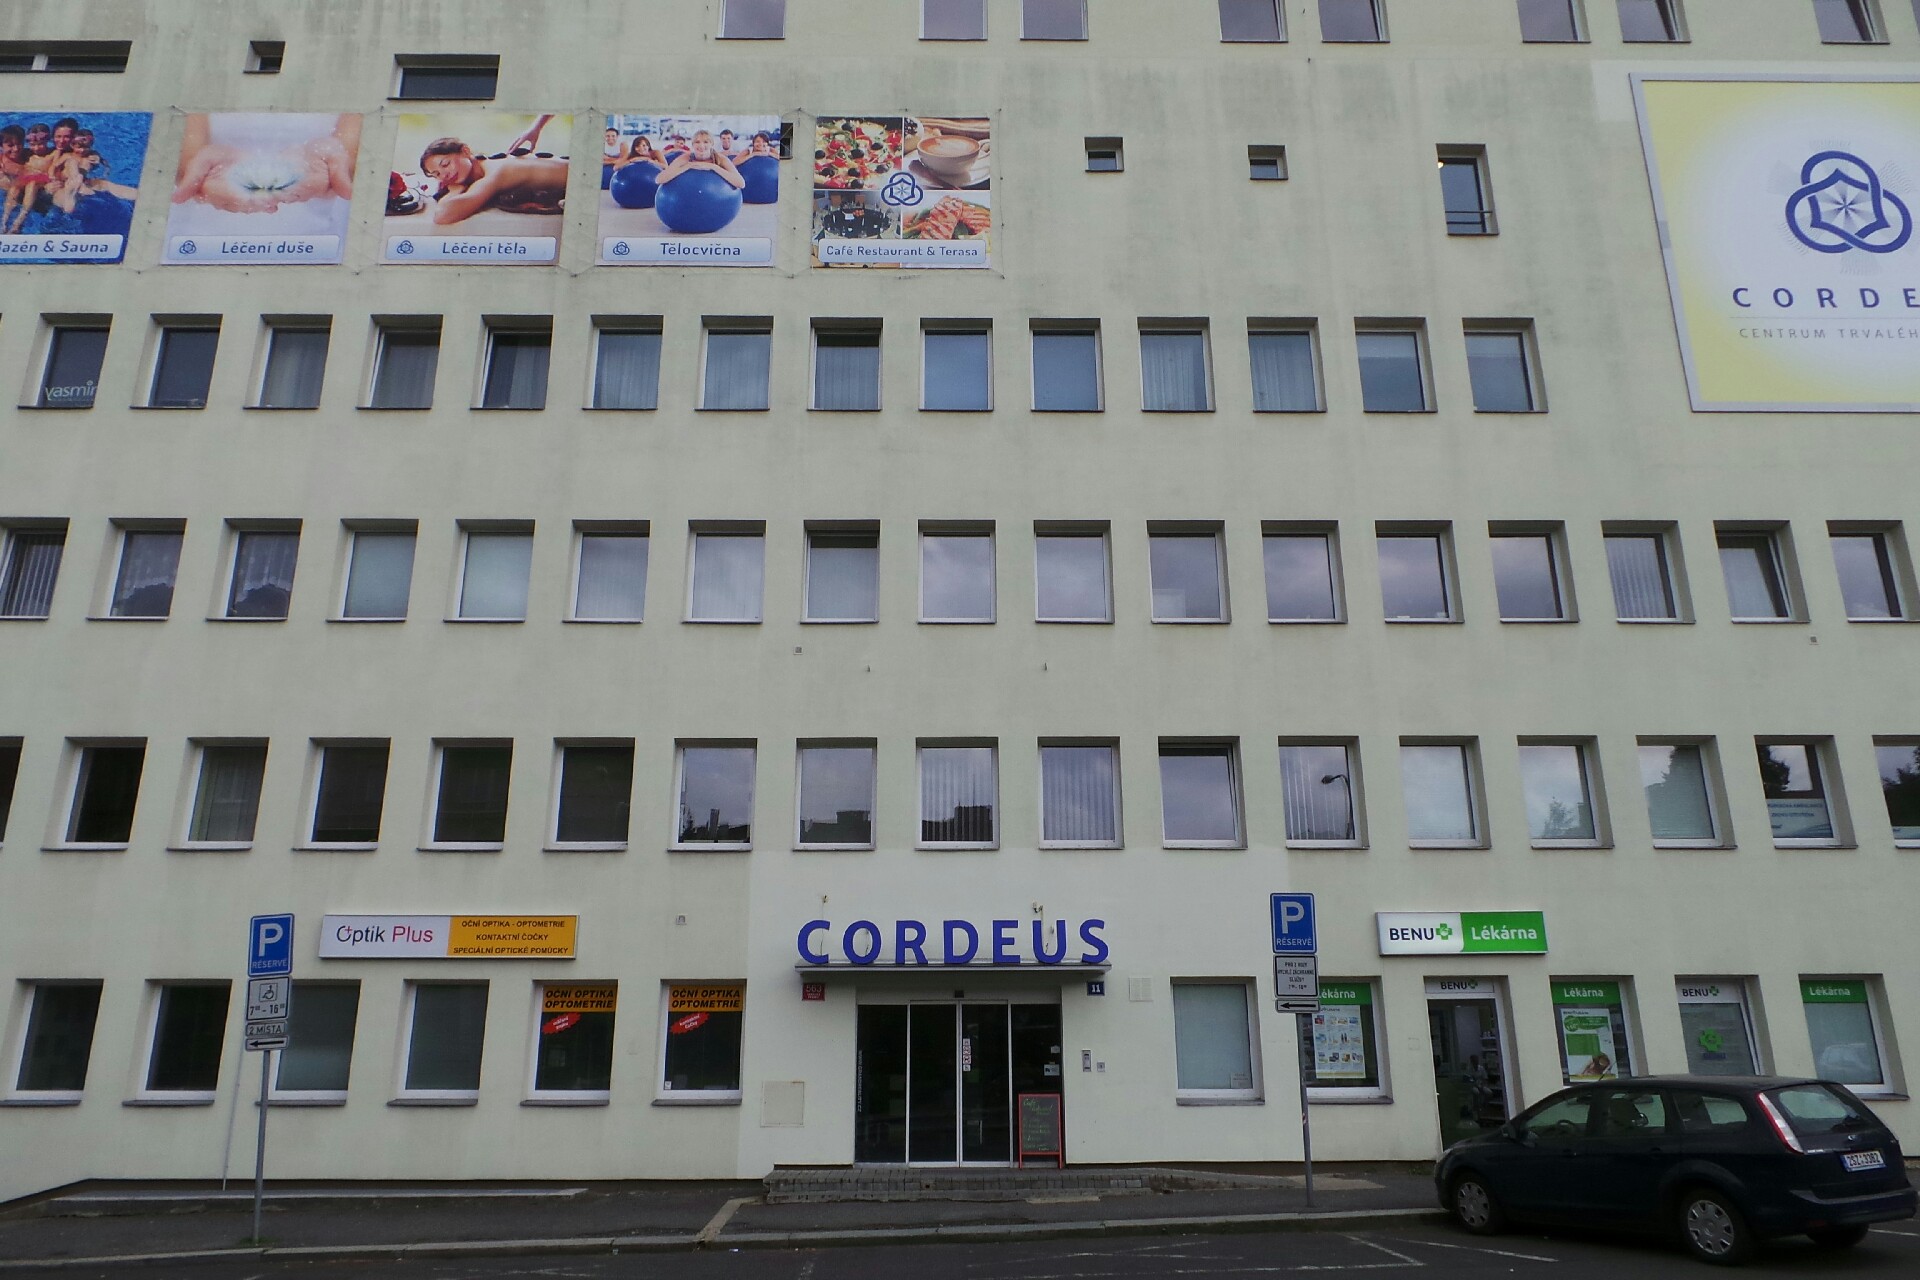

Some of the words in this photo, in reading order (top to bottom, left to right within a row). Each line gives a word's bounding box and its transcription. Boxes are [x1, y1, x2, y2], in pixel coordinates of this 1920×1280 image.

[43, 240, 54, 253] &
[60, 240, 109, 253] Sauna
[222, 241, 273, 254] Léčení
[276, 241, 314, 254] duše
[442, 242, 493, 255] Léčení
[497, 242, 527, 255] těla
[660, 241, 741, 257] Tělocvična
[826, 245, 854, 257] Café
[856, 245, 923, 257] Restaurant
[926, 246, 936, 257] &
[939, 246, 979, 257] Terasa
[1732, 287, 1920, 308] CORDE
[1739, 328, 1826, 339] CENTRUM
[1838, 326, 1918, 339] TRVALÉH
[461, 919, 480, 928] OČNÍ
[482, 920, 510, 928] OPTIKA
[516, 920, 565, 928] OPTOMETRIE
[1280, 901, 1305, 934] P
[336, 925, 386, 947] Optik
[392, 925, 433, 943] Plus
[476, 933, 520, 941] KONTAKTNÍ
[521, 933, 549, 941] ČOČKY
[1389, 928, 1434, 941] BENU
[1471, 924, 1538, 940] Lékárna
[258, 922, 284, 957] P
[797, 919, 1109, 964] CORDEUS
[453, 946, 494, 954] SPECIÁLNÍ
[494, 946, 529, 954] OPTICKÉ
[1091, 984, 1101, 993] 11
[1440, 981, 1468, 990] BENU
[1809, 985, 1851, 997] Lékárna
[574, 989, 614, 998] OPTIKA
[699, 989, 740, 998] OPTIKA
[1318, 987, 1356, 999] ékárna
[1563, 987, 1604, 997] Lékárna
[1682, 988, 1709, 997] BENU
[545, 1000, 613, 1009] OPTOMETRIE
[671, 1000, 740, 1009] OPTOMETRIE
[249, 1026, 254, 1035] 2
